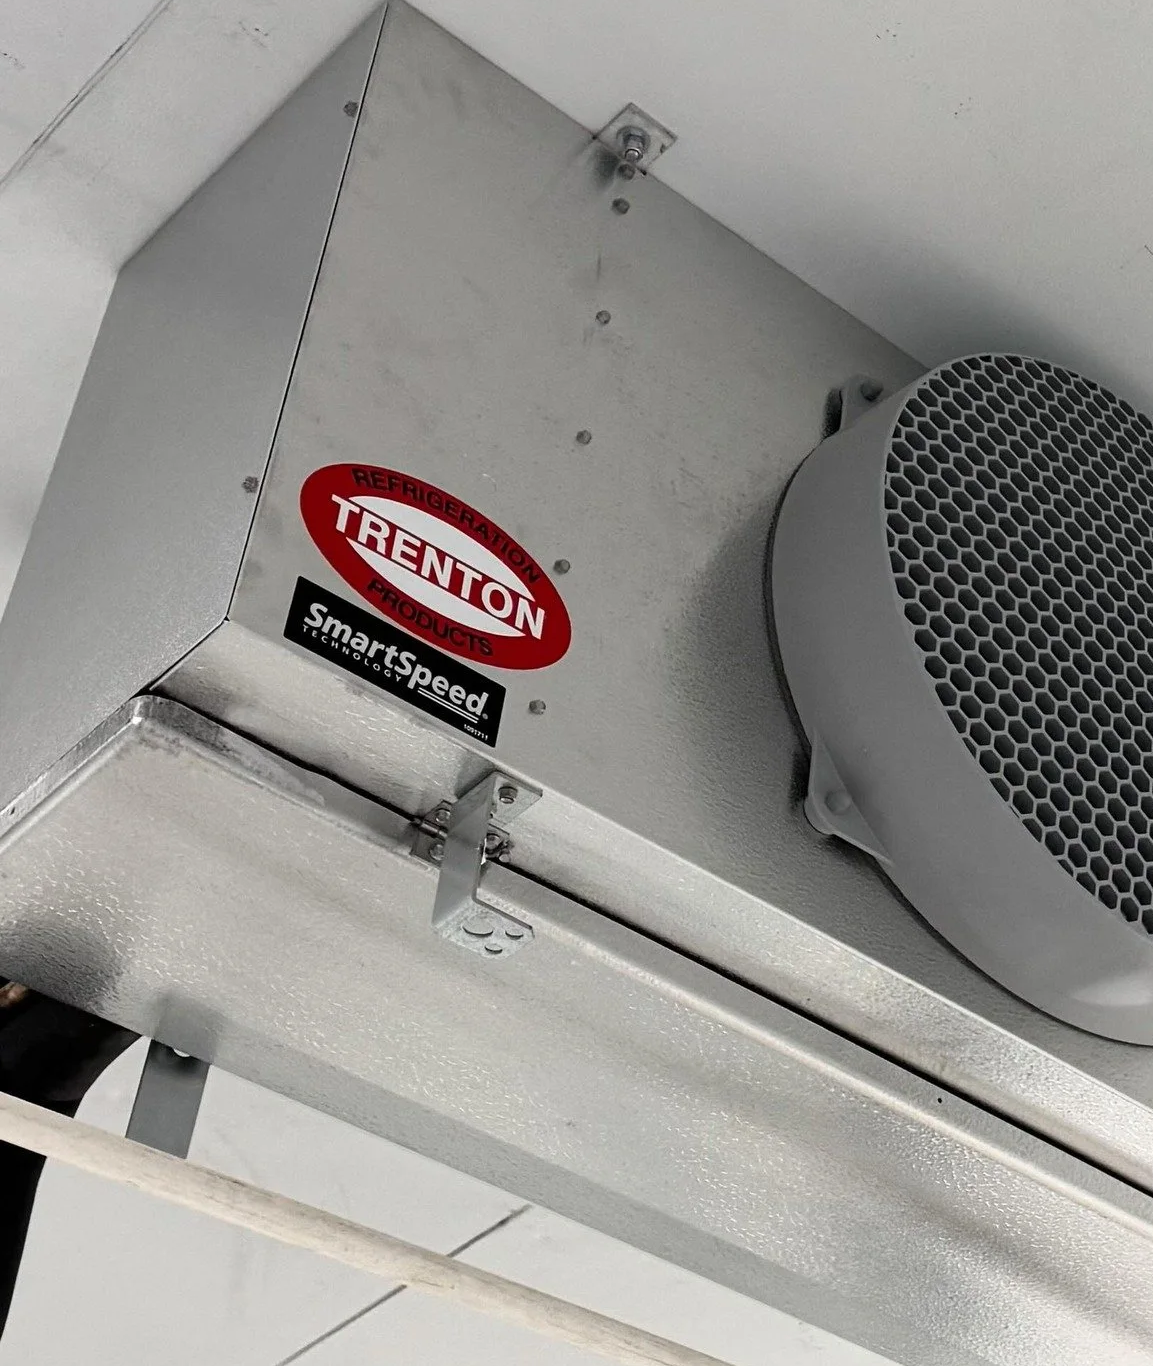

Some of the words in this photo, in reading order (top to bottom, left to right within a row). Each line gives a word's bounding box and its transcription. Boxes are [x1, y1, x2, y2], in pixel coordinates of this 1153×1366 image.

[331, 494, 545, 640] TRENTON
[352, 468, 540, 584] REFRIGERATION
[303, 624, 402, 682] TECHNOLOGY
[304, 603, 489, 716] SmartSpeed
[367, 578, 494, 656] PRODUCTS
